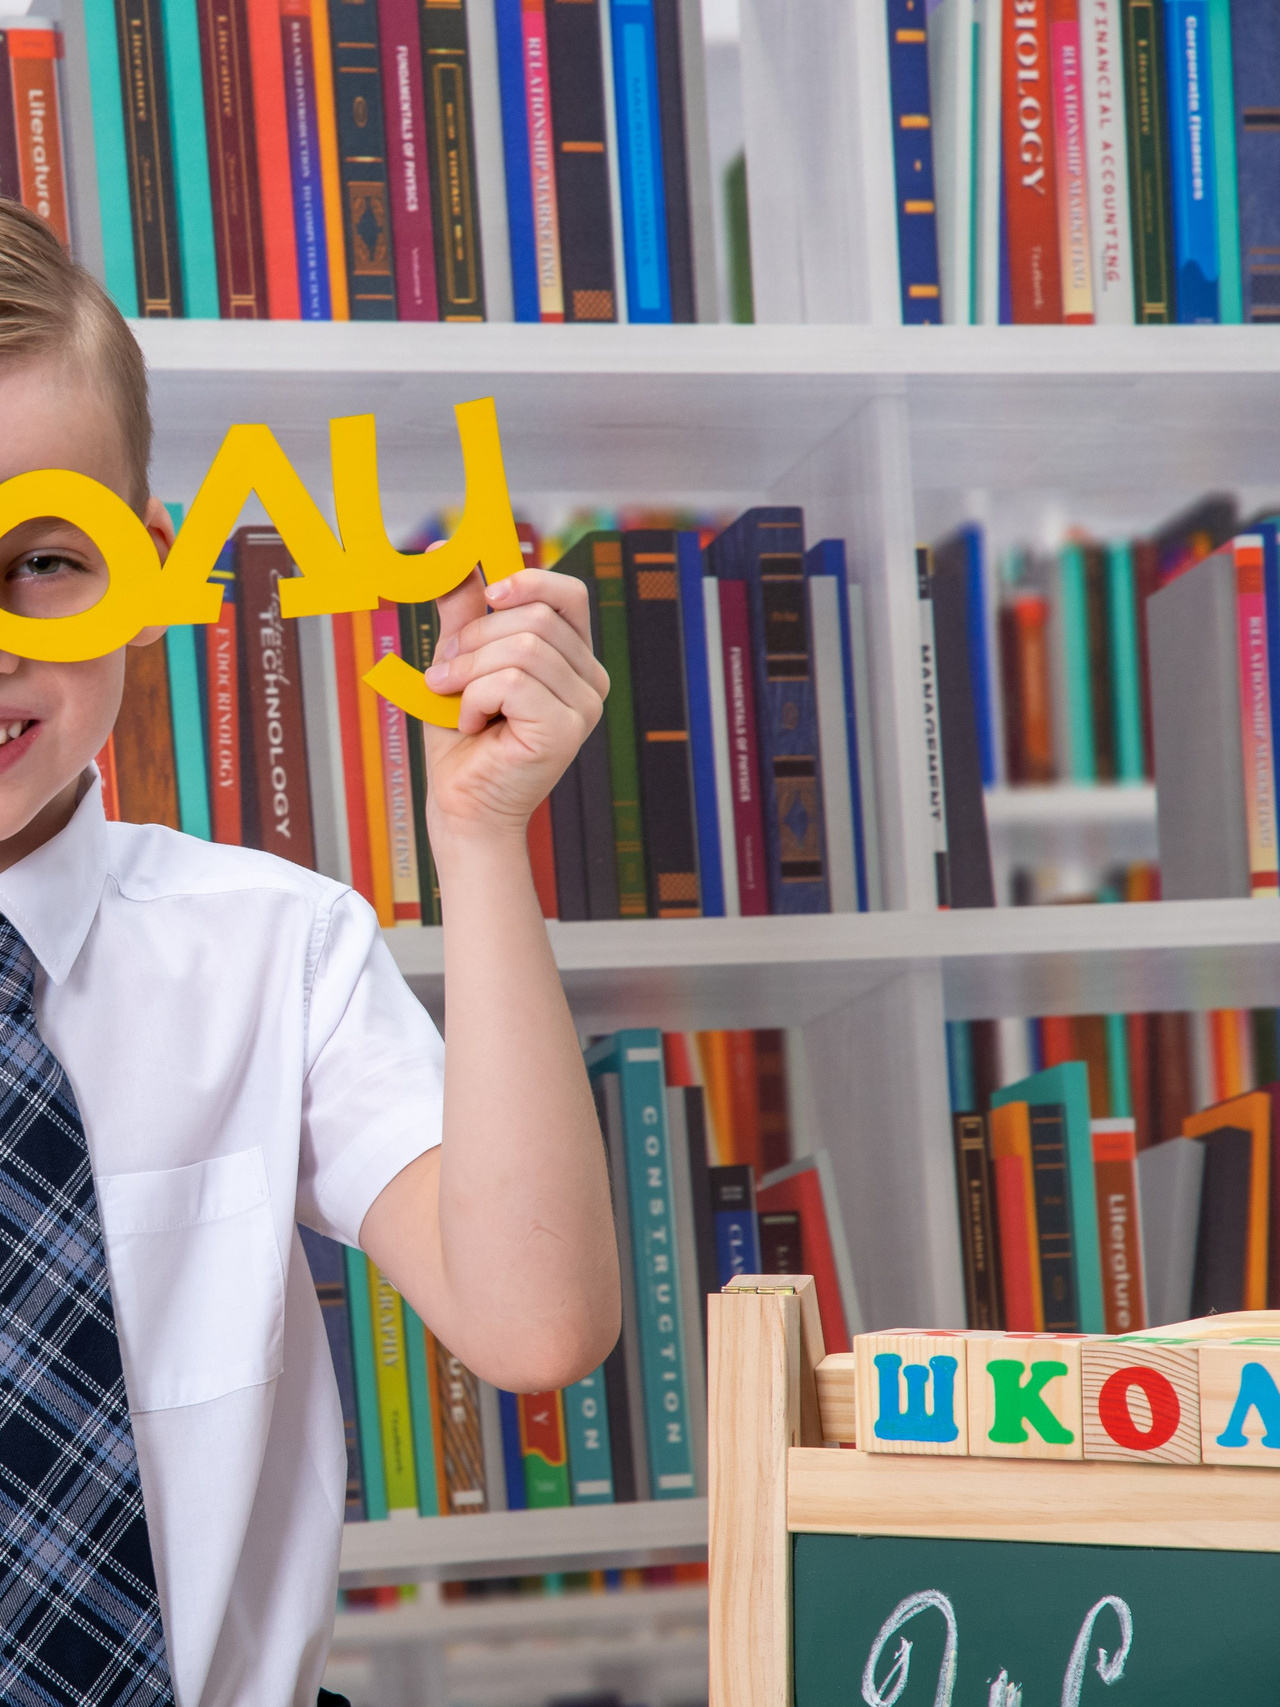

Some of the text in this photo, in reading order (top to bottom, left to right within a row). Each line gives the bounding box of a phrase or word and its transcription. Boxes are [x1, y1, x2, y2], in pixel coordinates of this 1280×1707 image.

[131, 19, 148, 122] Literature
[218, 15, 233, 119] Literature
[397, 45, 419, 212] FUNDAMENTALS OF PHYSICS
[1095, 0, 1112, 129] FINANCIAL
[1186, 15, 1200, 112] Corporate
[27, 88, 51, 219] Literature
[528, 37, 556, 288] RELATIONSHIP MARKETING
[1061, 45, 1087, 290] RELATIONSHIP MARKETING
[1102, 140, 1119, 282] ACCOUNTING
[215, 627, 234, 791] ENDOCRINOLOGY
[258, 609, 290, 839] TECHNOLOGY
[730, 646, 752, 803] FUNDAMENTALS OF PHYSICS
[921, 644, 942, 821] MANAGEMENT
[1249, 616, 1268, 739] RELATIONSHIP
[387, 768, 411, 879] MARKETING
[642, 1105, 681, 1444] CONSTRUCTION
[1109, 1193, 1131, 1329] Literature
[580, 1378, 600, 1449] ION
